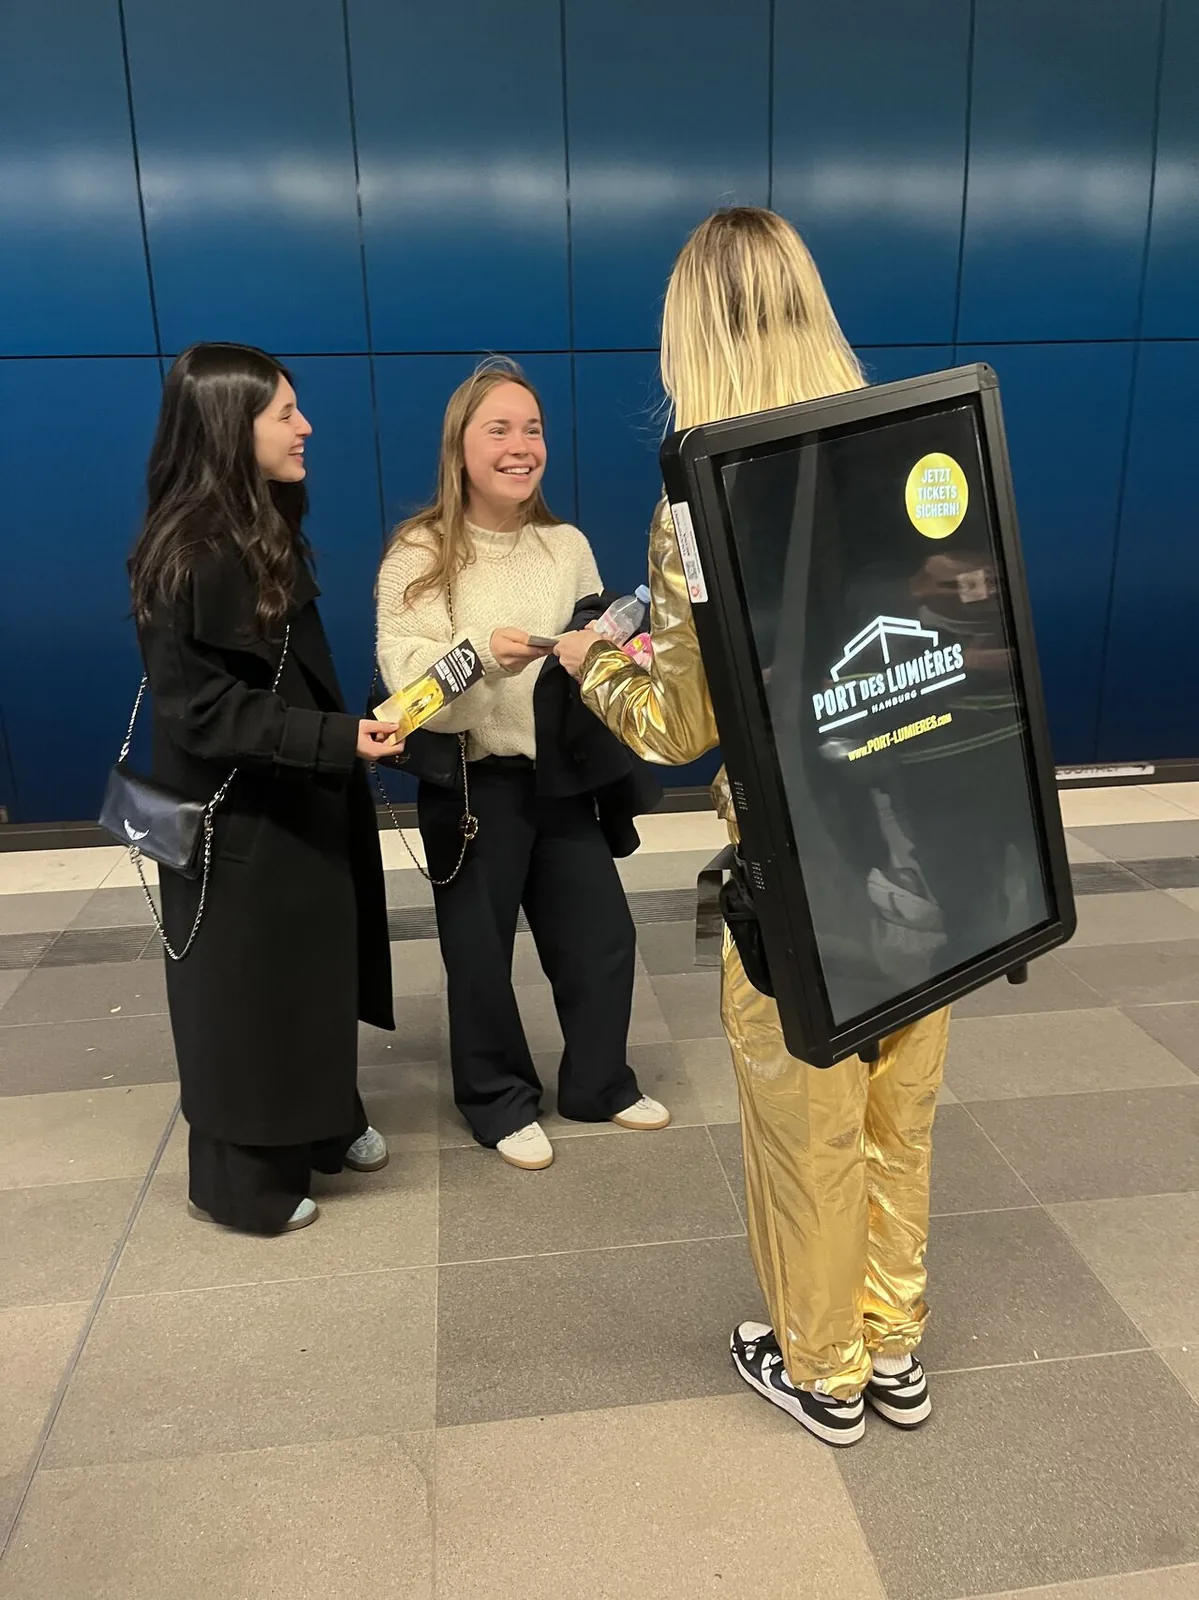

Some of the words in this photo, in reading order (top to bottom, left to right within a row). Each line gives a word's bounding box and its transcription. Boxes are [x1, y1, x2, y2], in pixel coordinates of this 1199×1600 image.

[922, 468, 951, 483] JETZT
[917, 485, 957, 500] TICKETS
[916, 502, 960, 519] SICHERN!
[812, 680, 857, 720] PORT
[860, 673, 886, 700] DES
[886, 643, 964, 693] LUMIÈRES
[871, 689, 918, 713] HAMBURG
